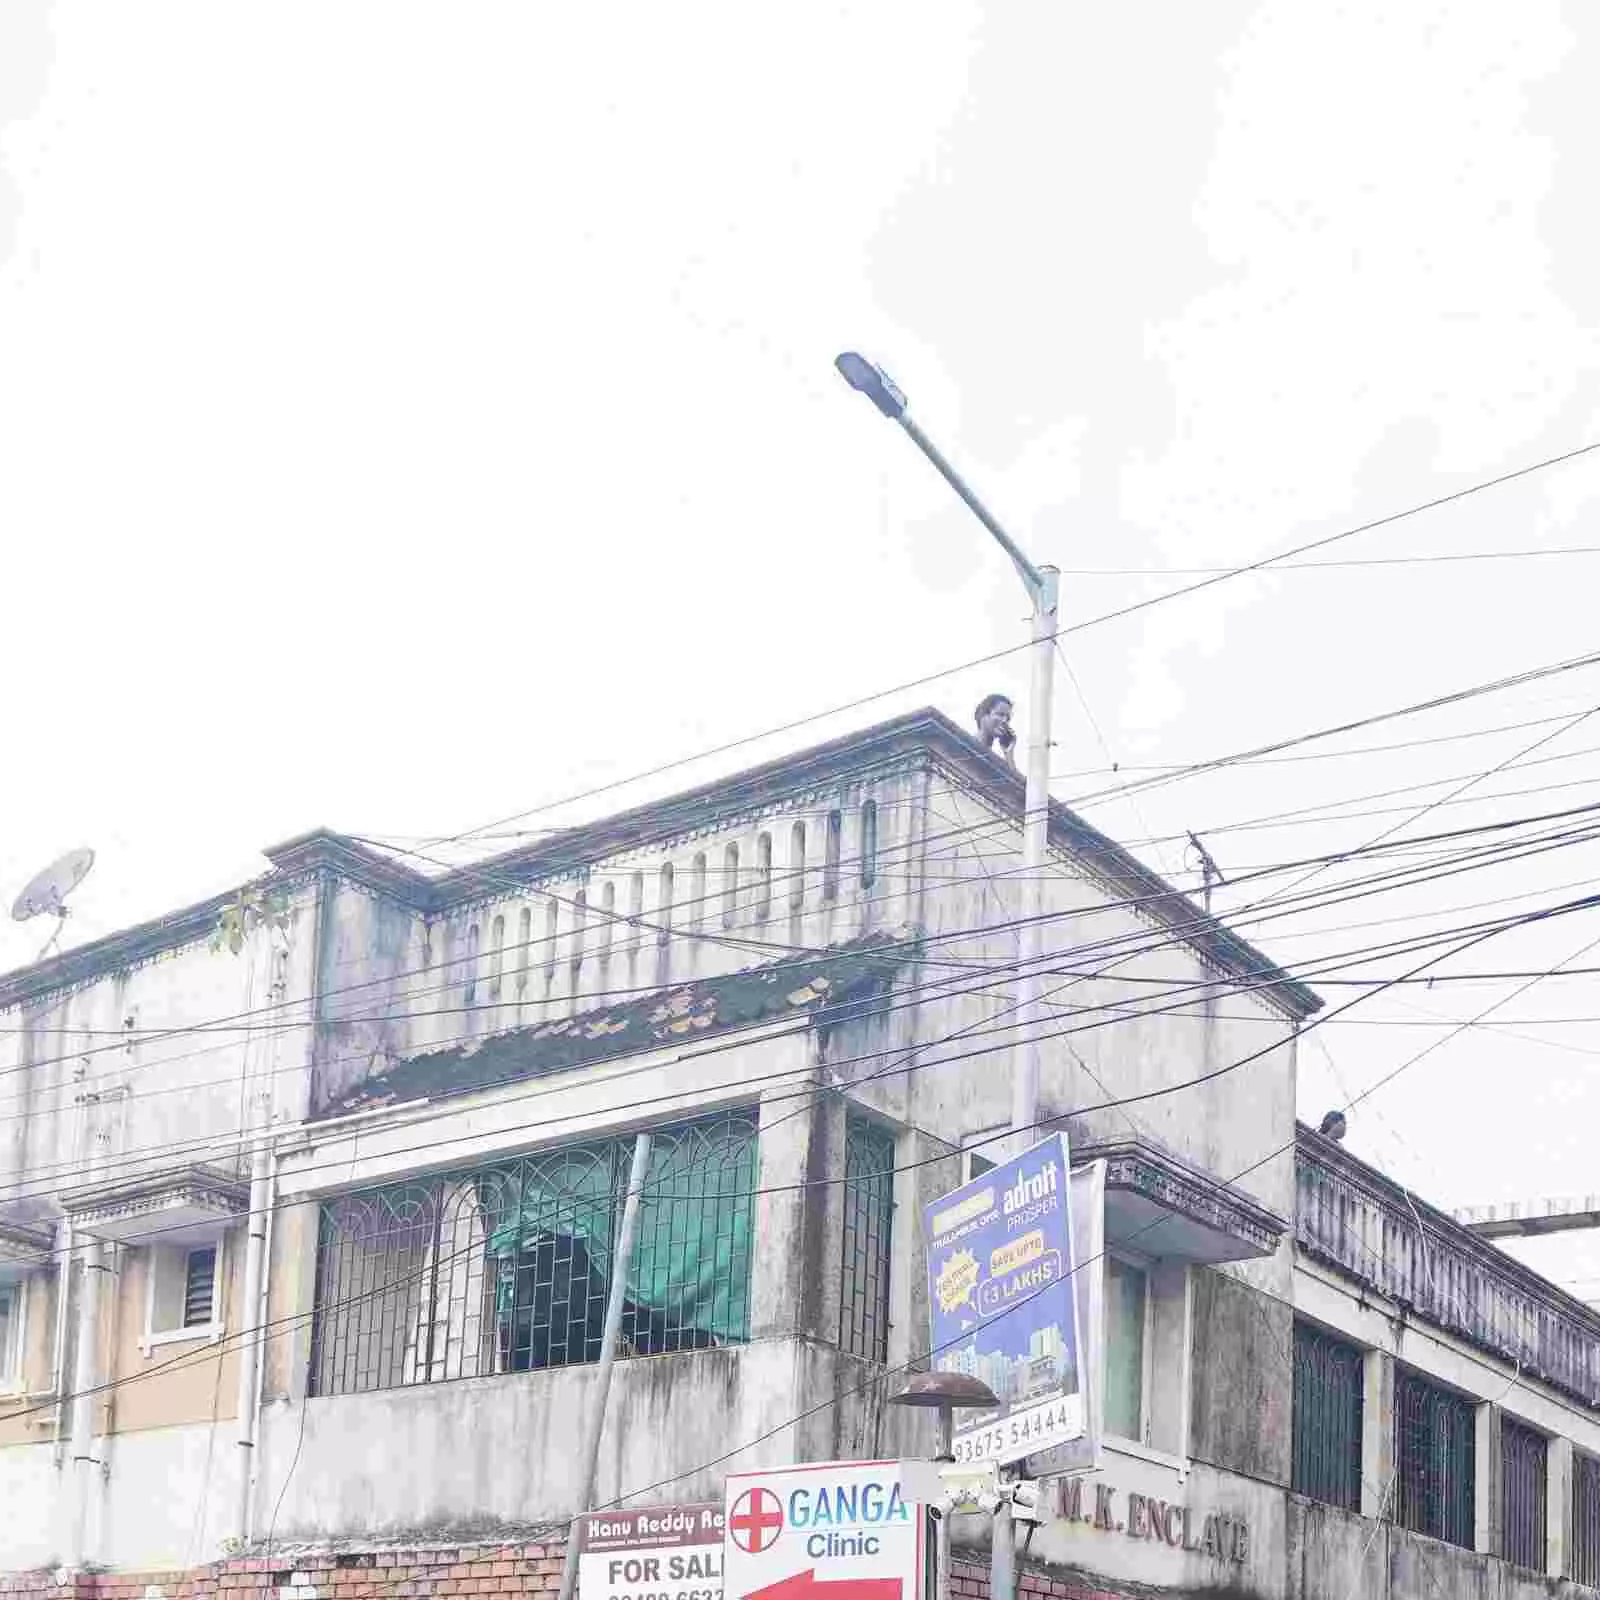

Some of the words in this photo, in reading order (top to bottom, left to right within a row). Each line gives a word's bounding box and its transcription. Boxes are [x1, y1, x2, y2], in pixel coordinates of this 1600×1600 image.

[789, 1481, 909, 1528] GANGA
[588, 1519, 632, 1538] Hanu
[637, 1512, 696, 1535] Reddy
[701, 1510, 725, 1529] Re
[807, 1531, 880, 1559] Clinic
[608, 1558, 661, 1585] FOR
